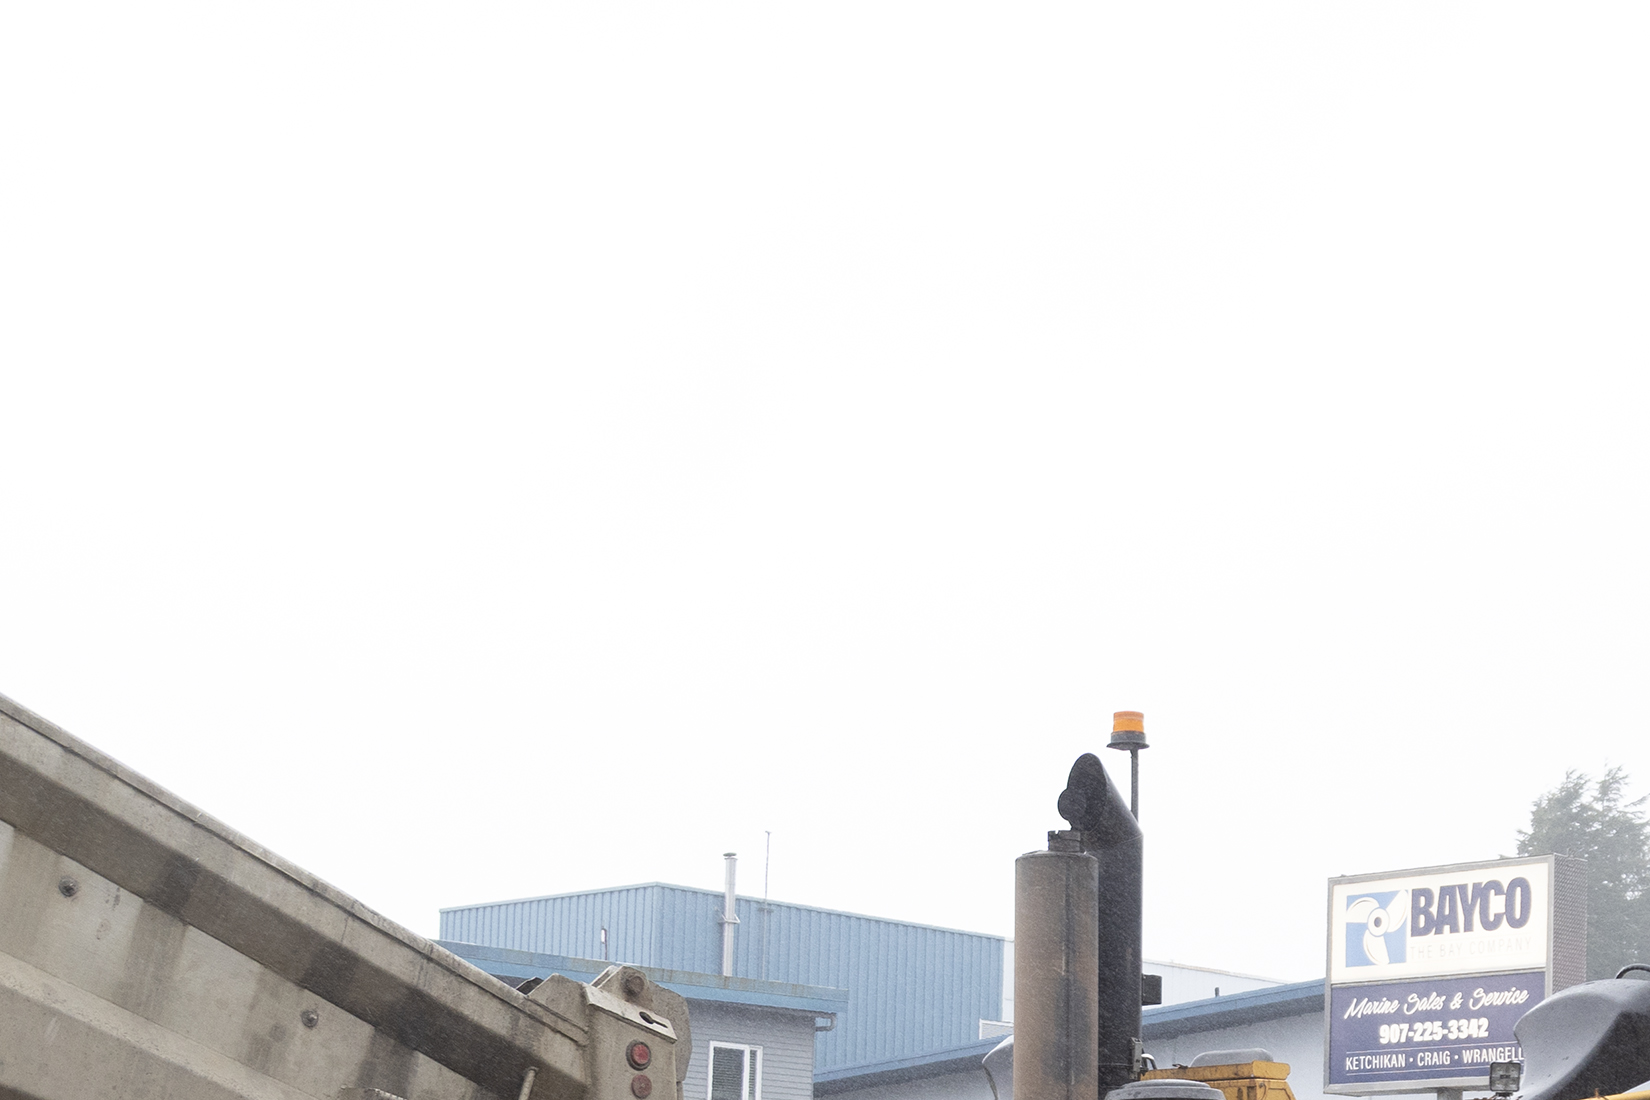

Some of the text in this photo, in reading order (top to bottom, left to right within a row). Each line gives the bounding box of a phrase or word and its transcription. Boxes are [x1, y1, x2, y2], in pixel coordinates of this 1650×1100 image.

[1410, 876, 1532, 937] BAYCO
[1410, 936, 1532, 960] THE BAY COMPANY
[1344, 987, 1529, 1019] Marine Sales & Service
[1379, 1017, 1489, 1044] 907-225-3342
[1345, 1046, 1525, 1071] KETCHIKAN CRAIG WRANGELL
